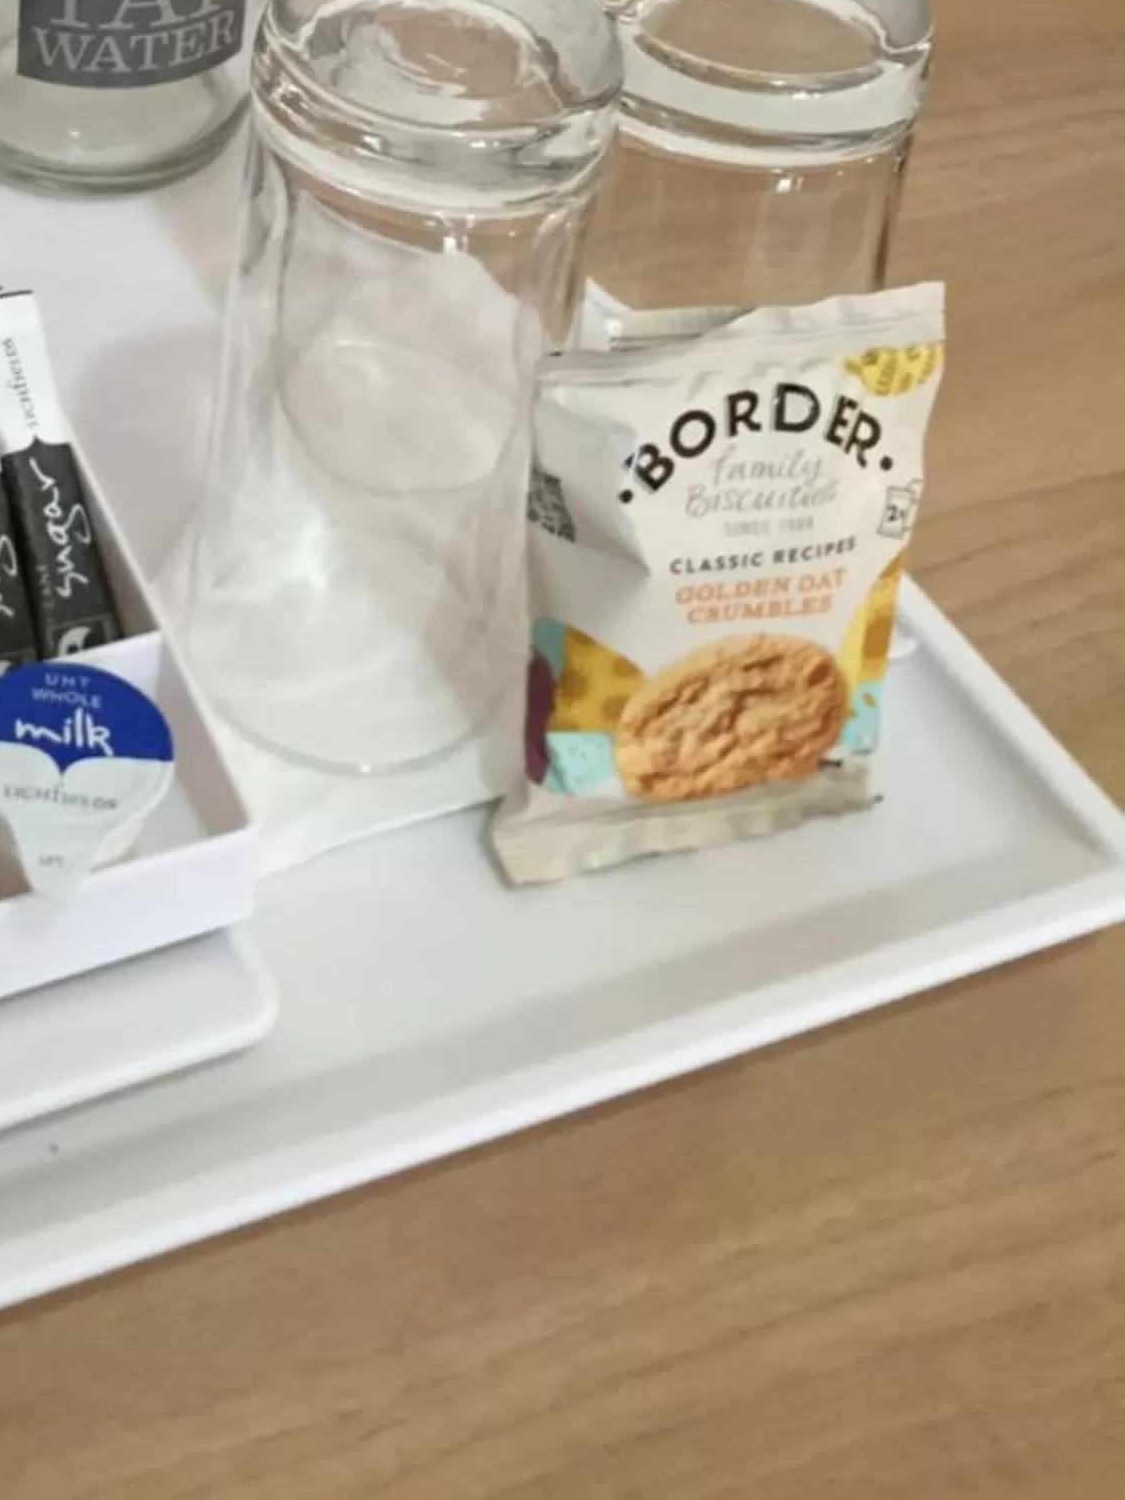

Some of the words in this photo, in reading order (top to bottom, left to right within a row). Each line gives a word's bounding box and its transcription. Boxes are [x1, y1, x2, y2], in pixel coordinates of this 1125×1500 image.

[31, 10, 236, 73] WATER
[625, 383, 882, 492] BORDER
[669, 551, 764, 576] CLASSIC
[773, 536, 858, 565] RECIPES
[675, 574, 793, 605] GOLDEN
[798, 567, 848, 592] OAT
[687, 594, 834, 625] CRUMBLES
[15, 707, 115, 757] milk
